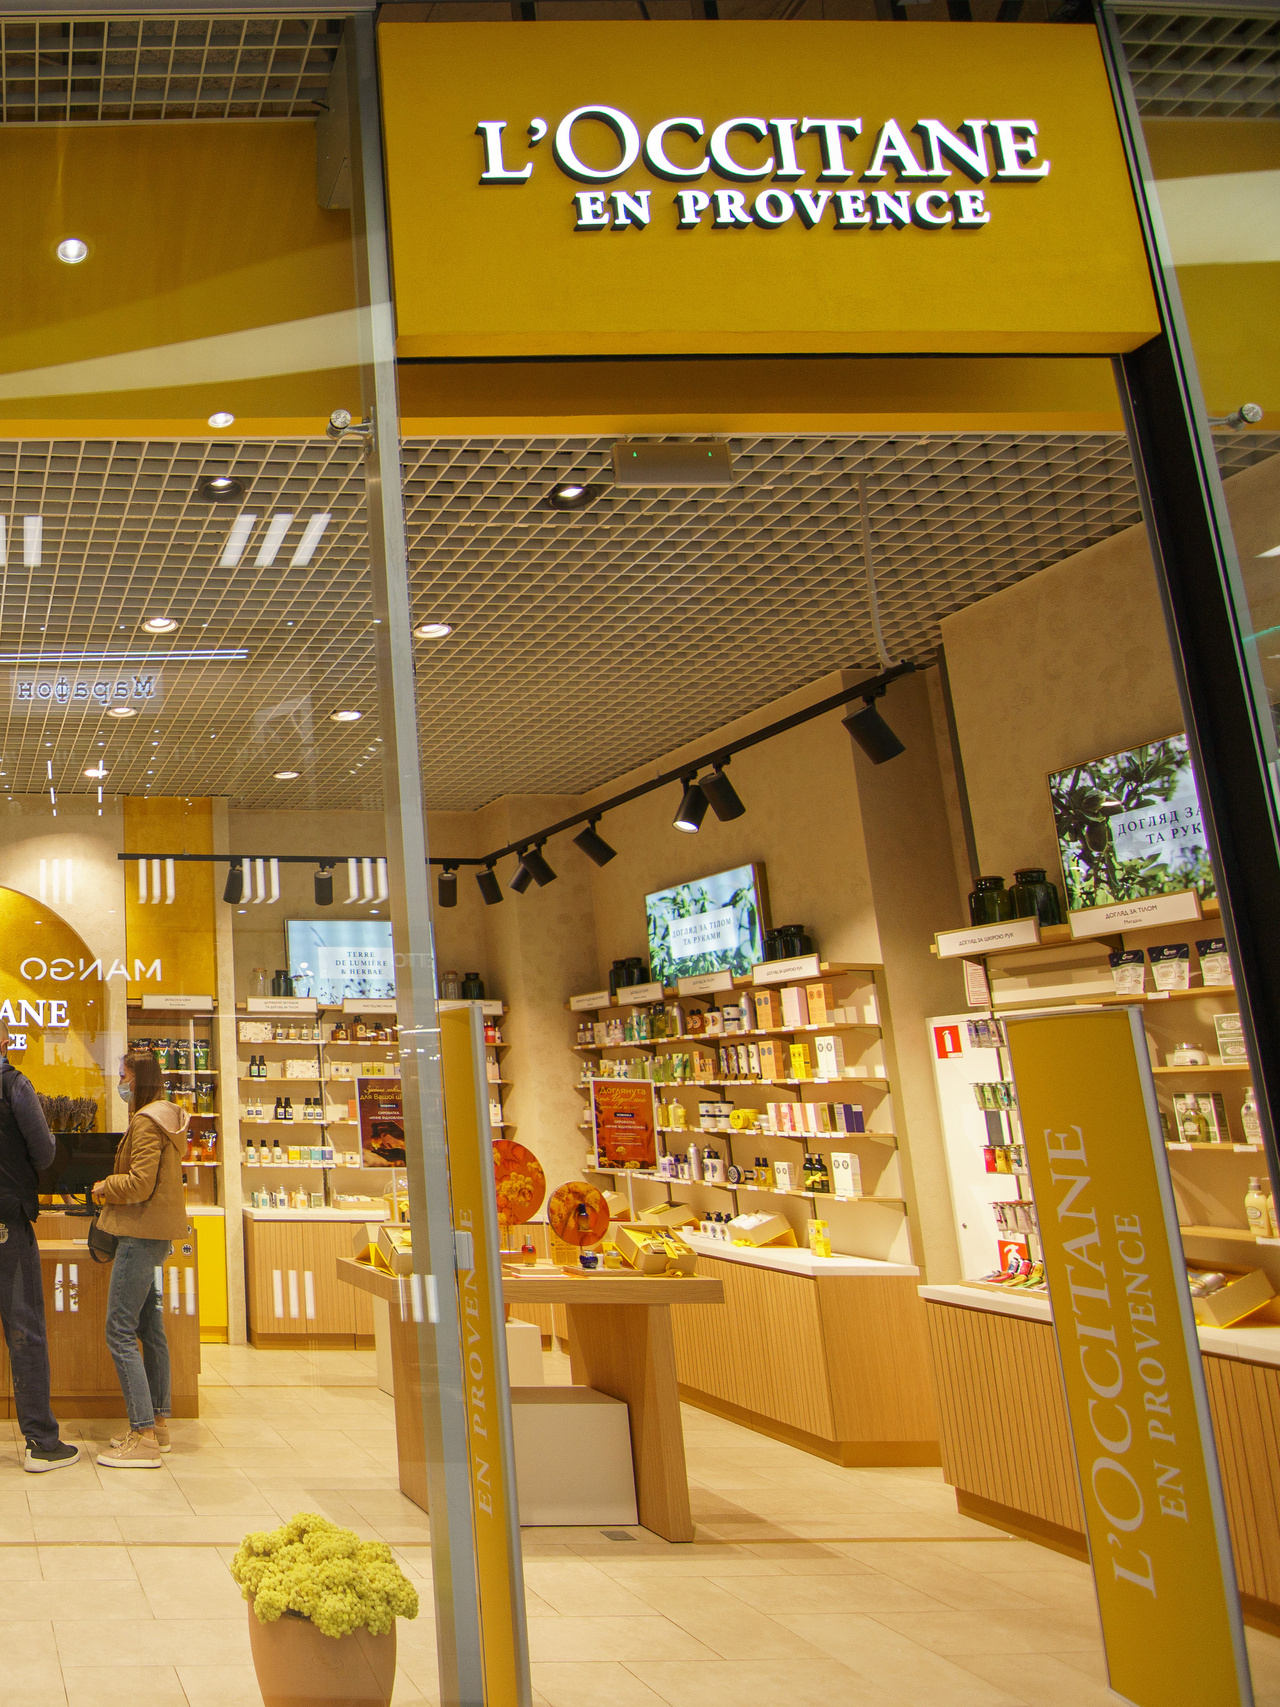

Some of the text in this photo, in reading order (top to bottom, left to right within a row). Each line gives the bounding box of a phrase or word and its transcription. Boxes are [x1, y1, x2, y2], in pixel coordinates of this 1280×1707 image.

[575, 189, 991, 226] EN PROVENCE
[1117, 810, 1180, 838] ДОГЛЯД
[1145, 831, 1166, 845] ТА
[1105, 904, 1158, 920] ДОГЛЯД ЗА ТІЛОМ
[672, 918, 731, 939] ДОГЛЯД ЗА ТІЛОМ
[683, 931, 721, 946] ТА РУКАМИ
[958, 931, 1015, 947] ДОГЛЯД ЗА ШКІРОЮ РУК
[349, 959, 388, 967] LUMIÈRE
[600, 1086, 646, 1096] Доглянута
[459, 1208, 493, 1519] EN PROVENE
[1112, 1212, 1189, 1523] EN PROVENCE
